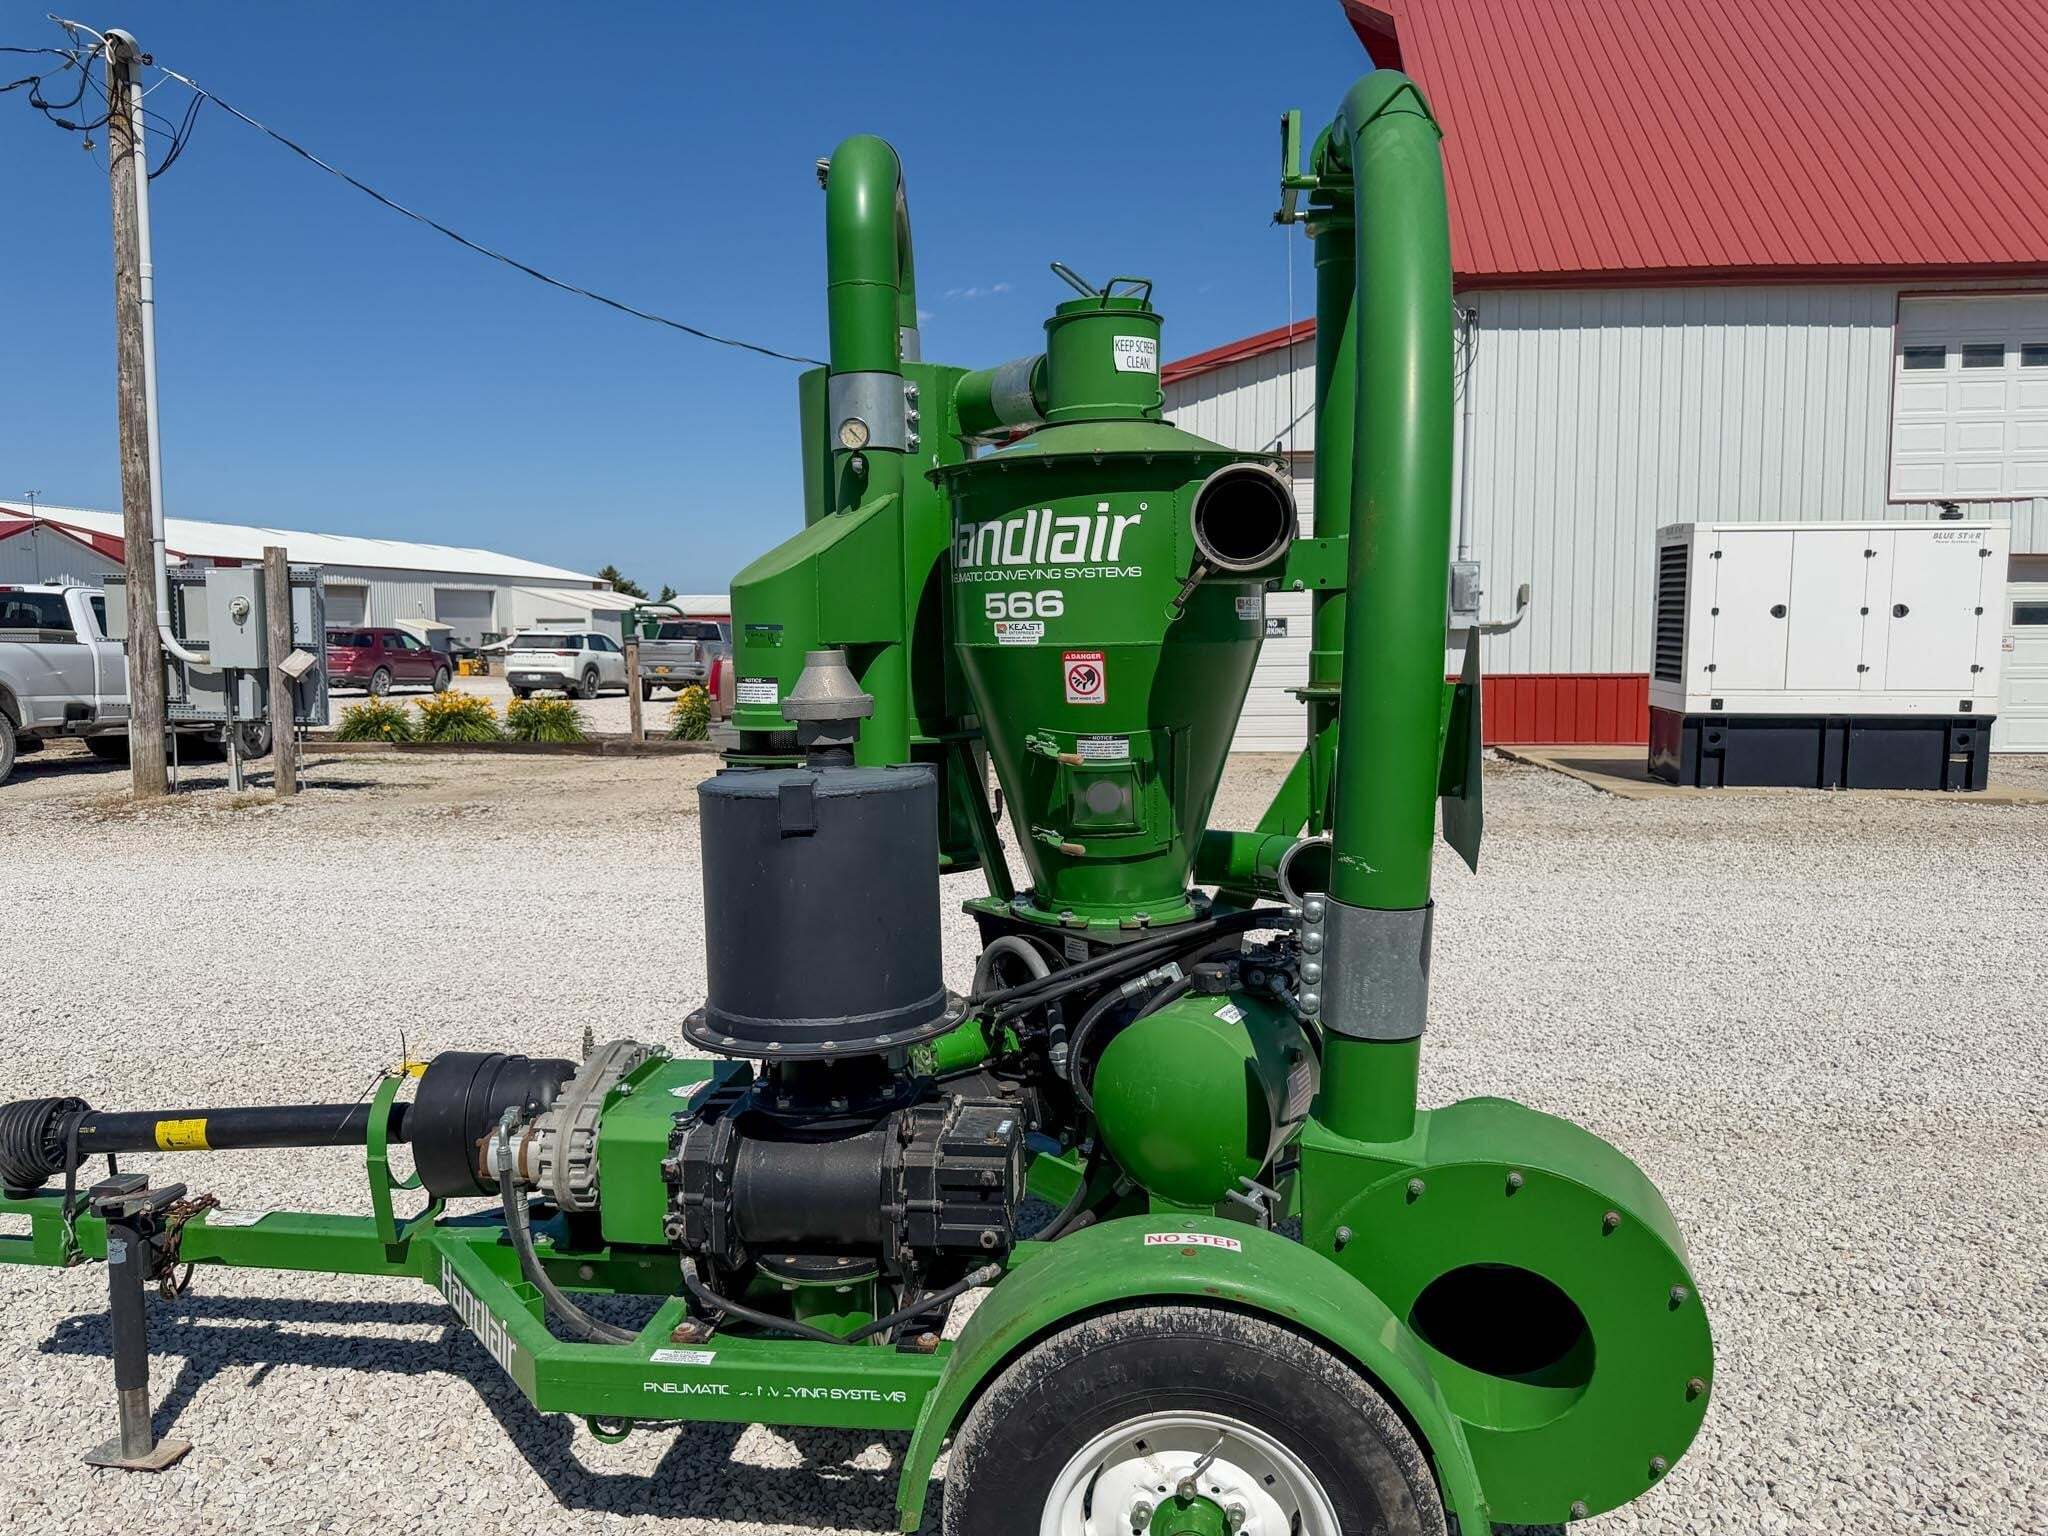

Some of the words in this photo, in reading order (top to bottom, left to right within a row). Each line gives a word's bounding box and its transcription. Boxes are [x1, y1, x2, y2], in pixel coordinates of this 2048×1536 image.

[1115, 339, 1134, 352] KEEP
[1136, 340, 1156, 354] SCREEN
[951, 571, 983, 584] EUMATIC
[984, 568, 1061, 582] CONVEYING
[1064, 567, 1142, 579] SYSTEMS
[985, 590, 1064, 619] 566
[1009, 623, 1042, 631] KEAST
[1266, 627, 1285, 635] RKING
[1147, 1235, 1180, 1243] NO
[1187, 1235, 1238, 1248] STEP
[441, 1254, 517, 1378] Handlair
[643, 1382, 730, 1396] PNEUMATIC
